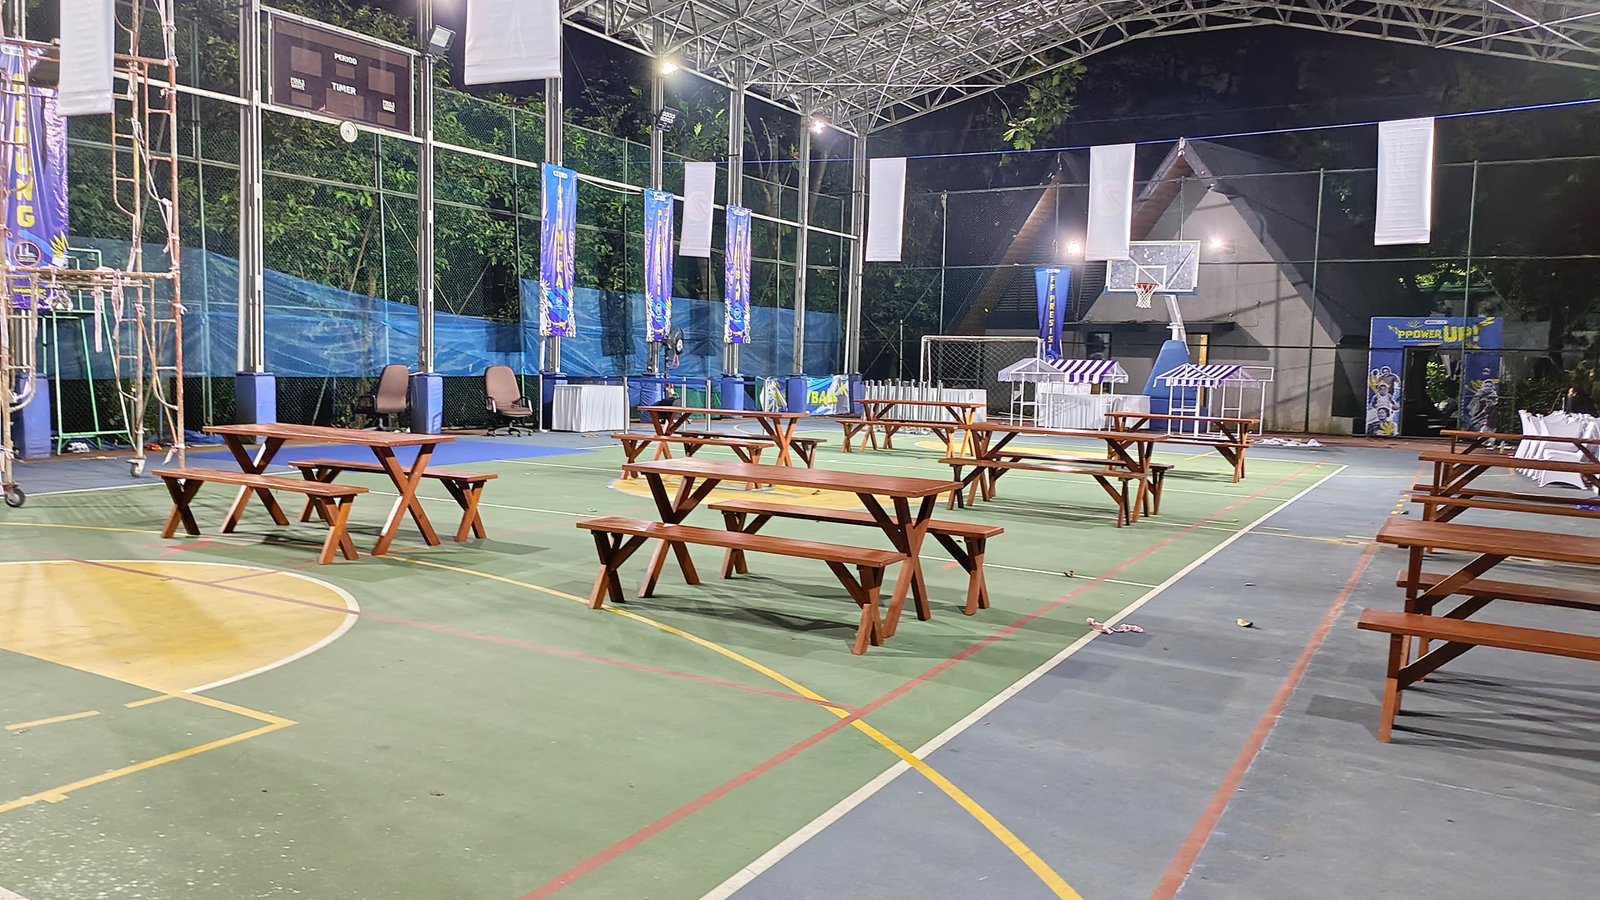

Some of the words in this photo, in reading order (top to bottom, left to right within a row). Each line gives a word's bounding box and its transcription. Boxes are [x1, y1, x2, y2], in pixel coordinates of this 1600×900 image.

[334, 53, 357, 65] PERIOD
[331, 82, 357, 95] TIMER
[1048, 295, 1056, 350] PRESISI
[1443, 325, 1479, 343] UP!
